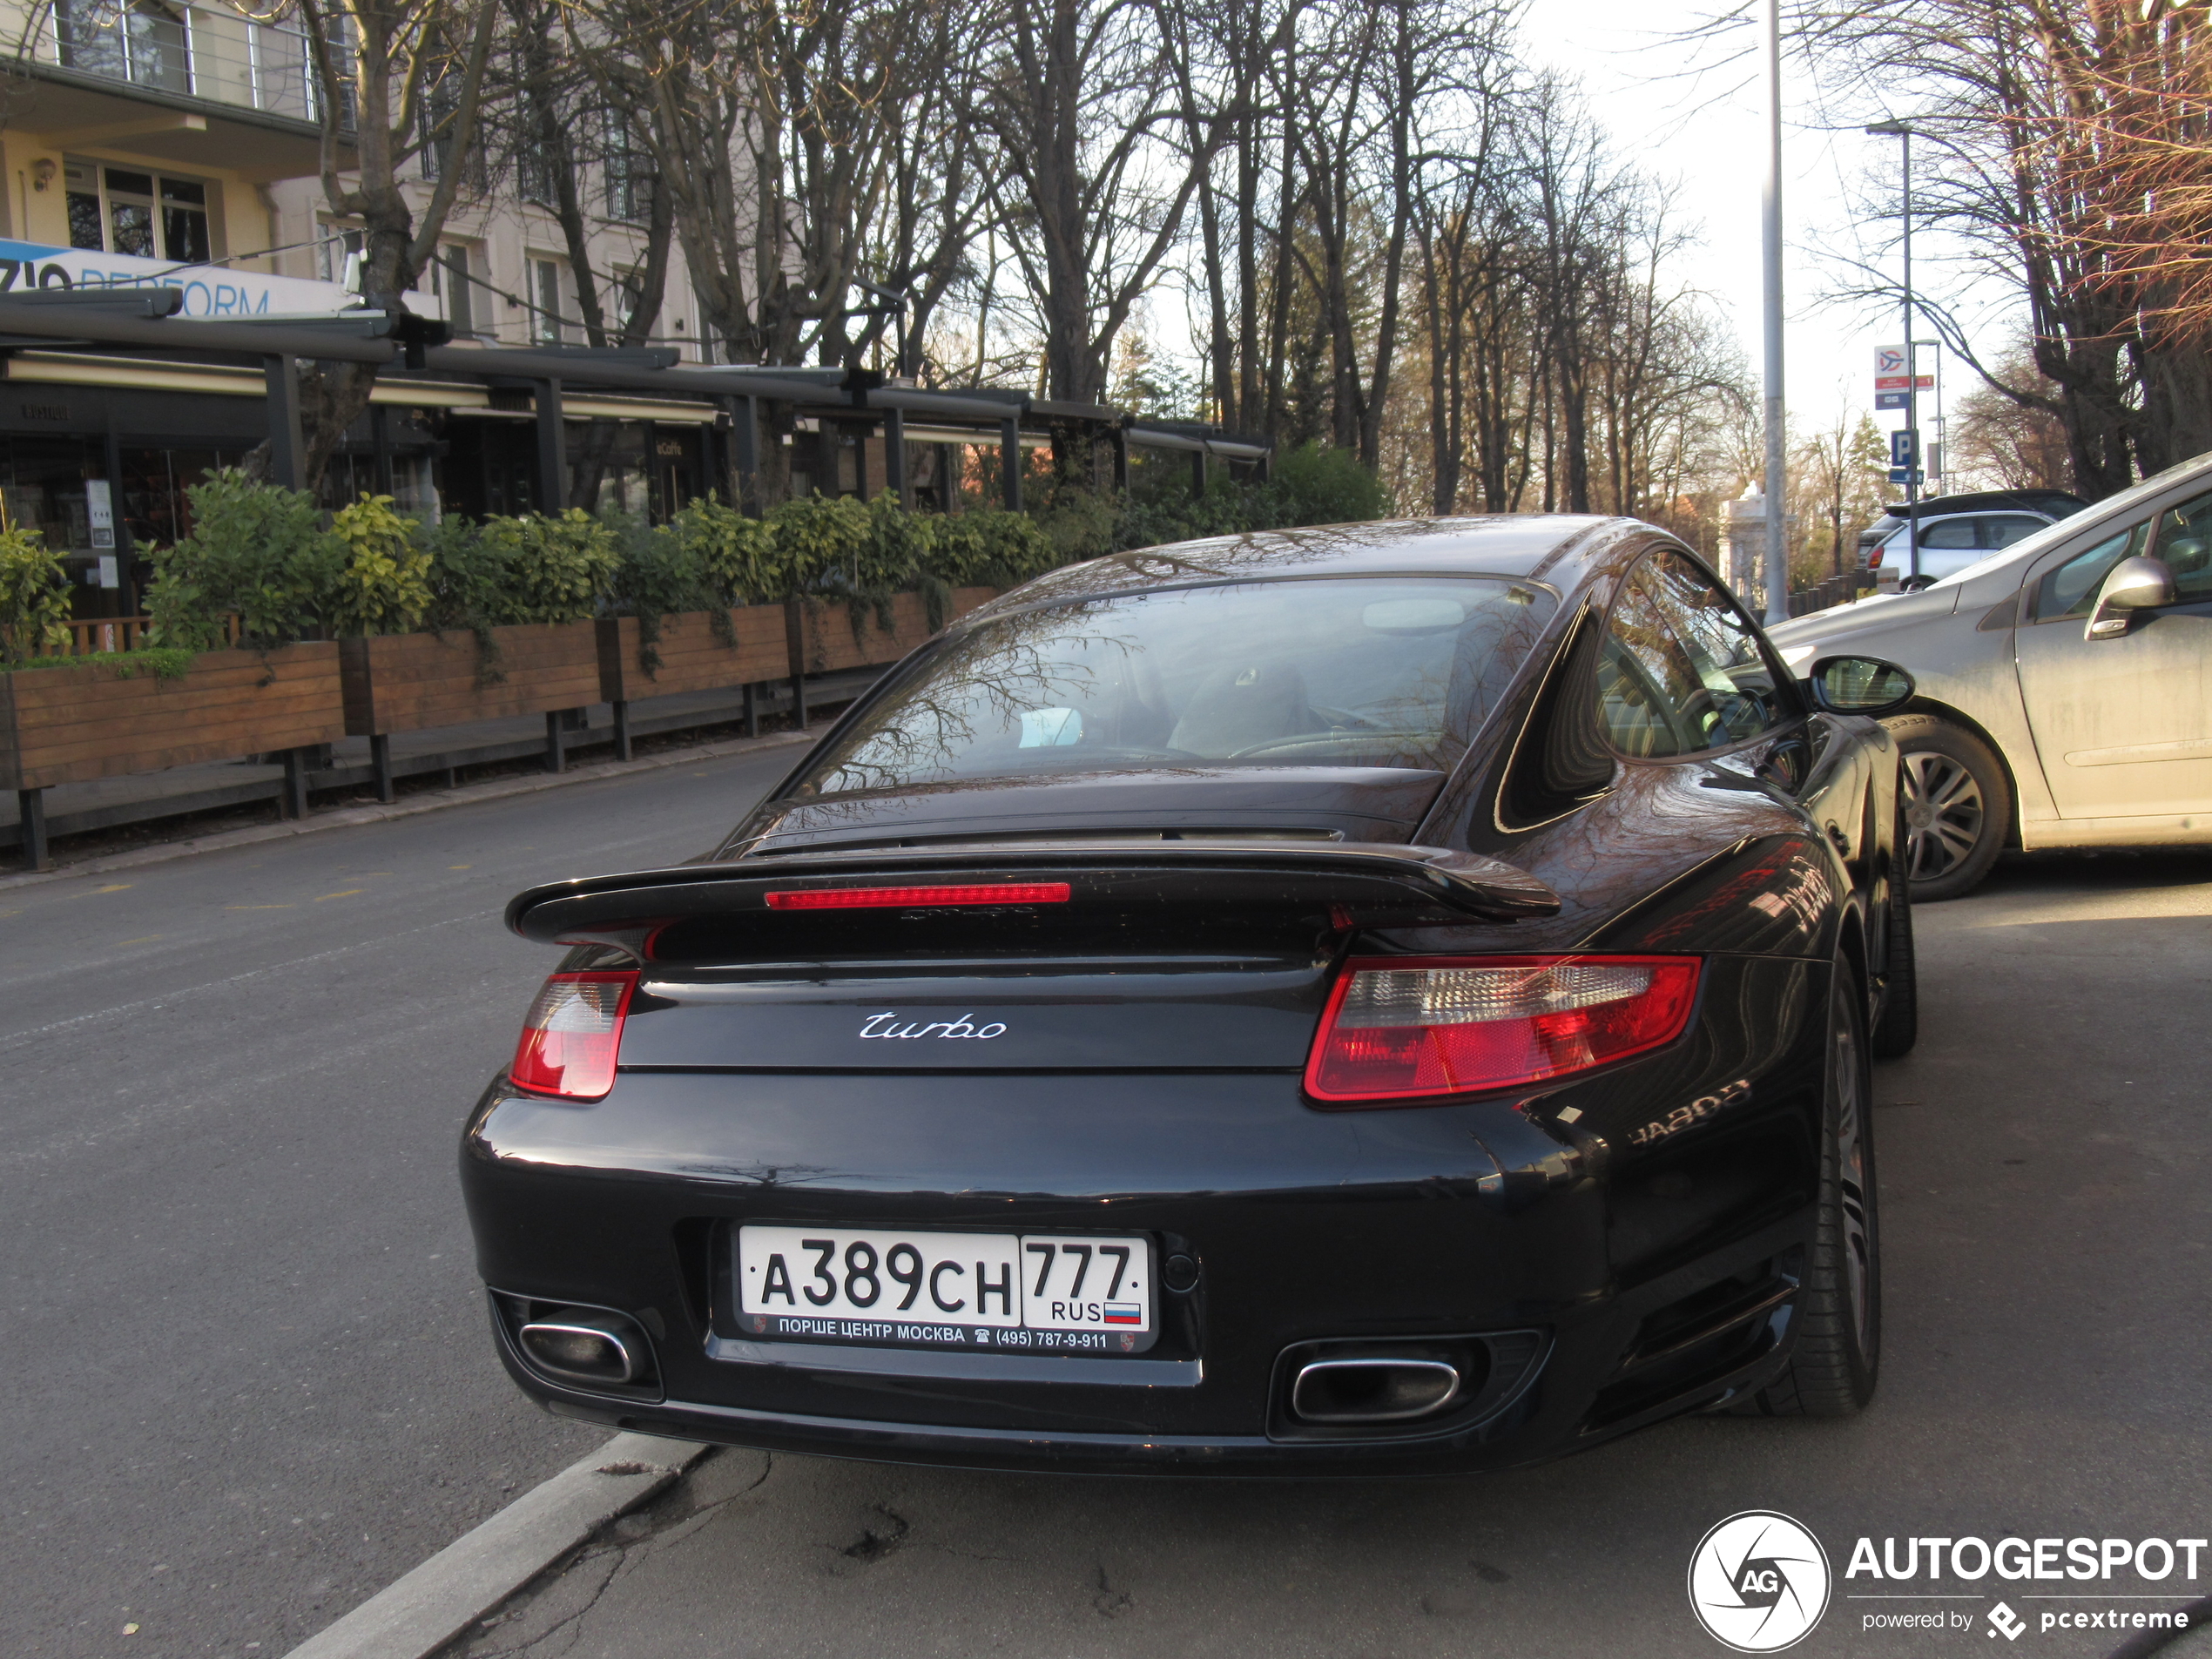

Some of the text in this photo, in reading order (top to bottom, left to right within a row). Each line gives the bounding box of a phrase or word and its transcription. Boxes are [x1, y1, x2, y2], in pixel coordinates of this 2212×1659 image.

[81, 268, 269, 315] PORM
[1898, 435, 1911, 462] P
[1020, 754, 1168, 767] PORSCHE
[860, 1011, 1008, 1039] turbo
[1026, 1243, 1131, 1300] 777
[1051, 1301, 1101, 1322] RUS
[779, 1318, 1107, 1348] ПОРШЕ ЦЕНТР МОСКВА (495) 787-9-911
